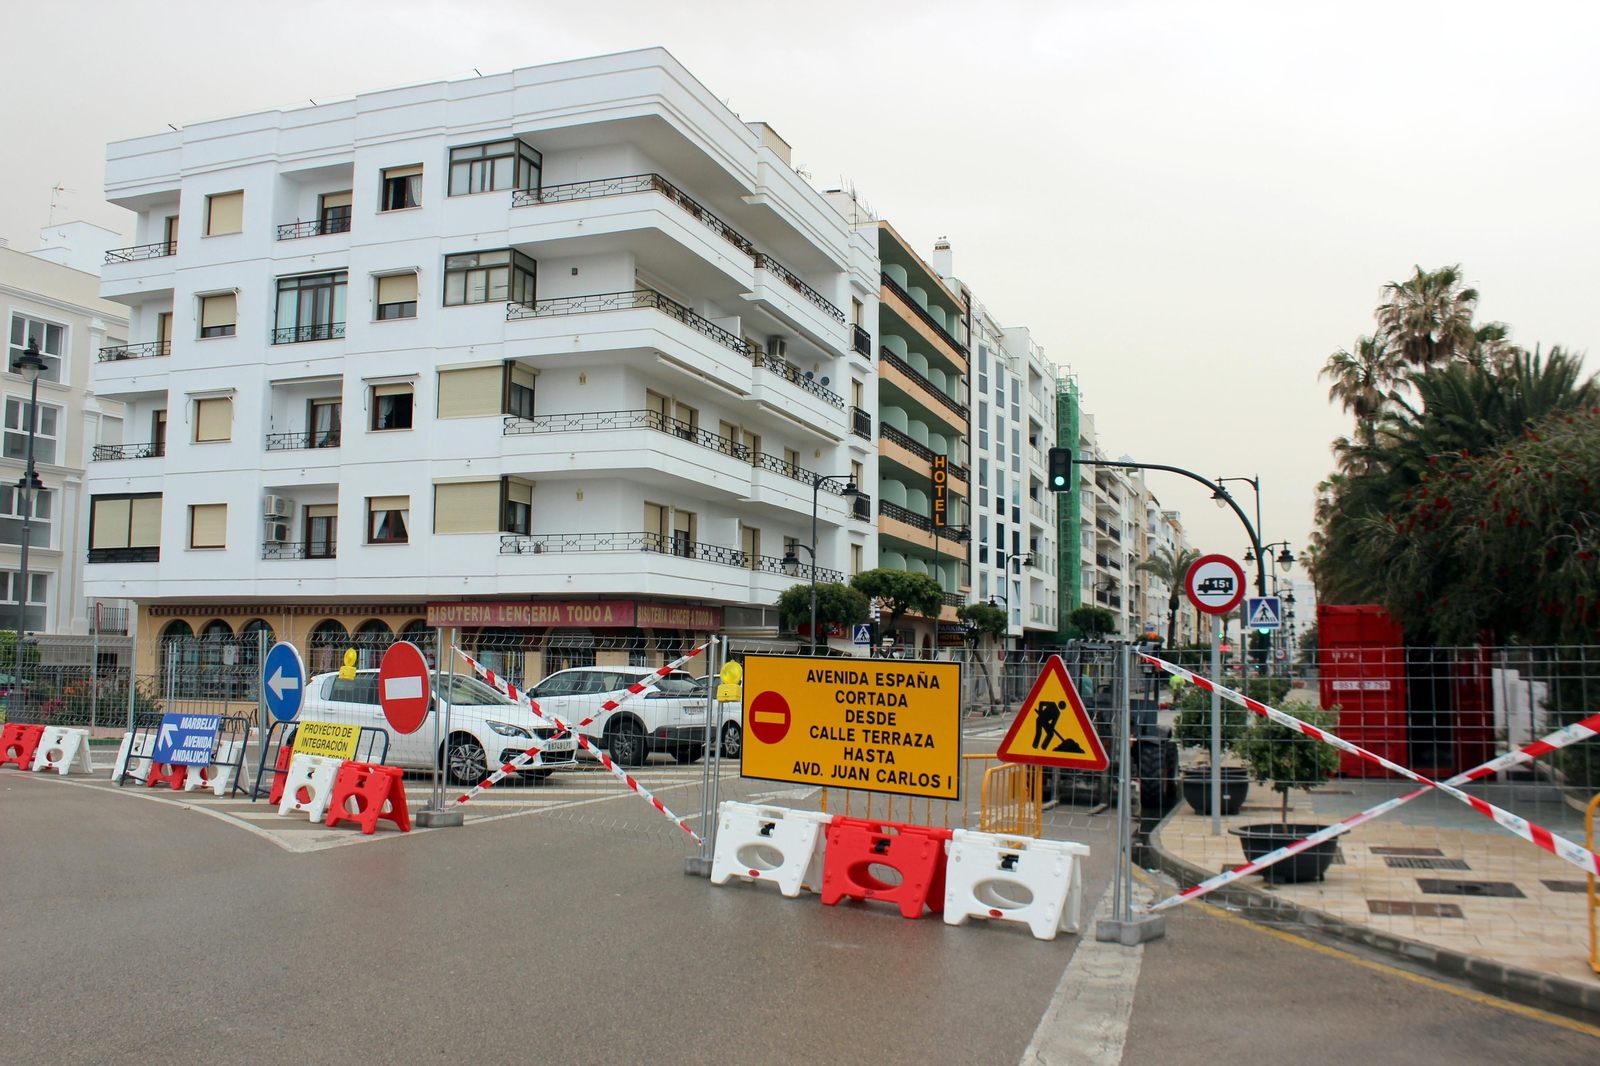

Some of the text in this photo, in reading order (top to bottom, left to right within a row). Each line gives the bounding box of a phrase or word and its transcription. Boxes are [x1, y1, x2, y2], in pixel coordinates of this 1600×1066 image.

[934, 456, 946, 526] HOTEL
[1211, 579, 1230, 588] 15t
[428, 606, 491, 622] BISUTERIA
[566, 605, 601, 622] TODO
[604, 605, 613, 622] A
[806, 669, 940, 689] AVENIDA ESPAÑA
[835, 690, 908, 708] CORTADA
[180, 717, 218, 730] MARBELLA
[845, 709, 896, 726] DESDE
[304, 723, 353, 738] PROYECTO DE
[809, 725, 935, 749] CALLE TERRAZA
[182, 735, 212, 749] AVENIDA
[301, 737, 348, 752] INTEGRACIÓN
[170, 748, 209, 763] ANDALUCÍA
[844, 747, 895, 765] HASTA
[793, 761, 952, 790] AVD. JUAN CARLOS I
